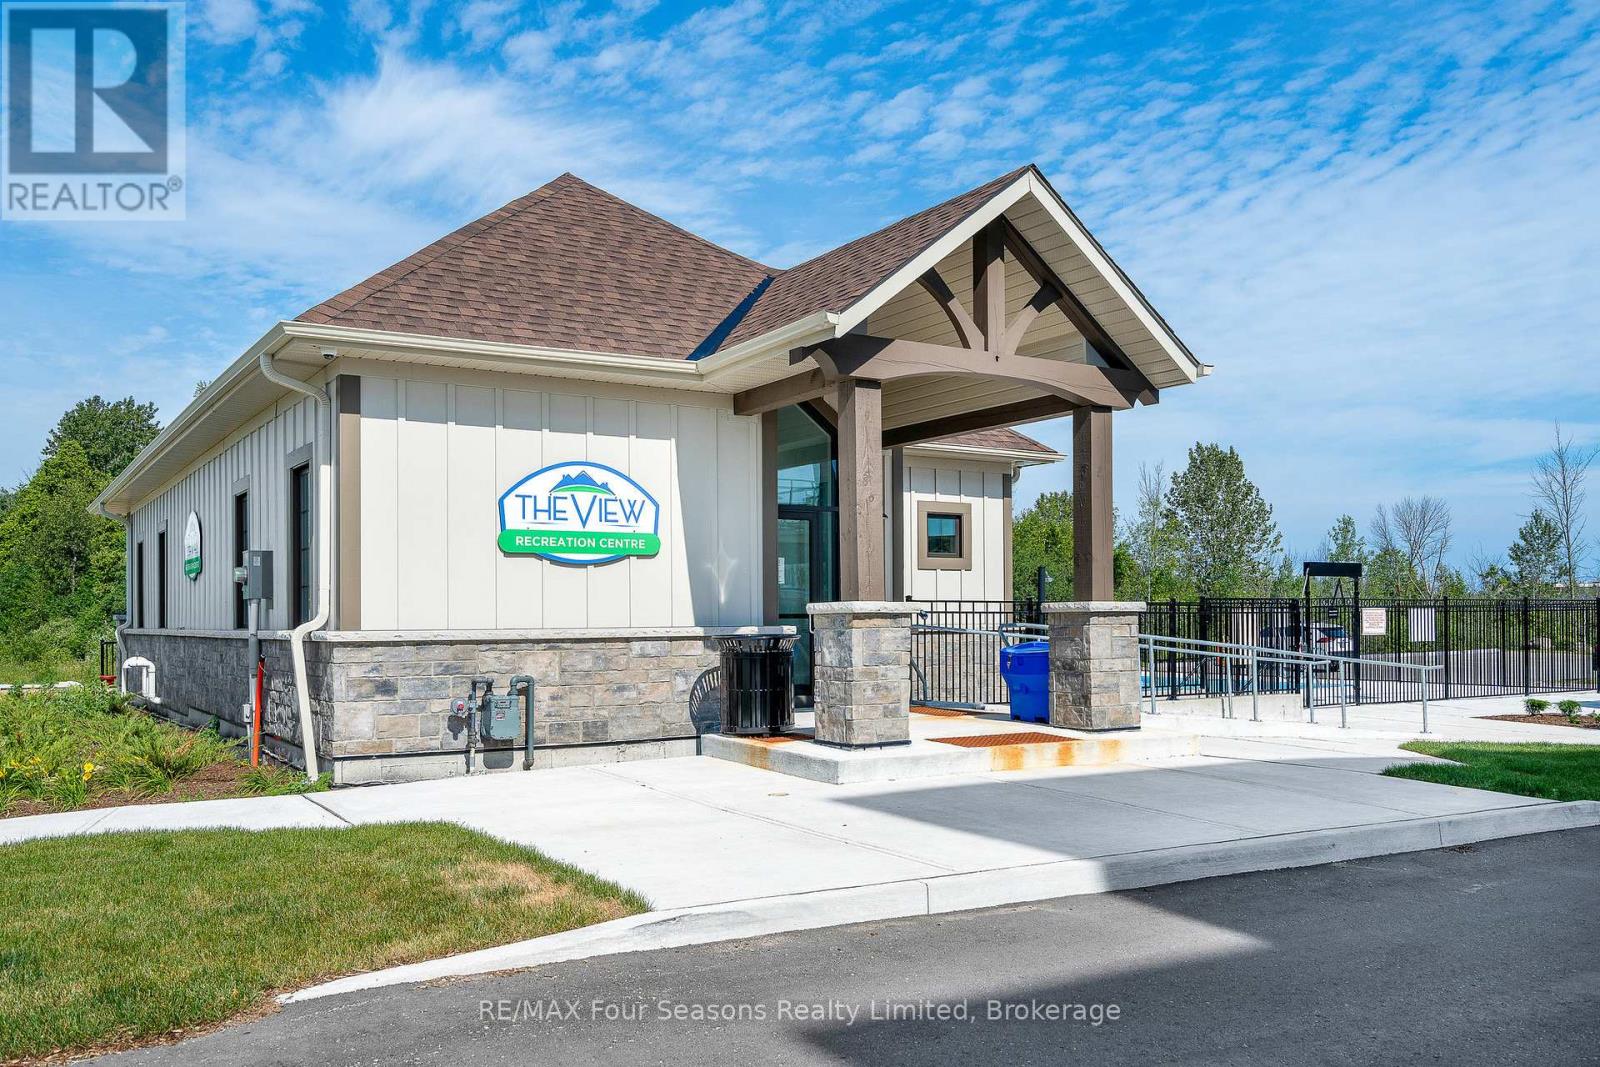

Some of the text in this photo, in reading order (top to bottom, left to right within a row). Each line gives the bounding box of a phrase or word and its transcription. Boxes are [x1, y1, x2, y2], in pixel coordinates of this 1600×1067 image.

[515, 494, 568, 521] THE
[515, 535, 646, 549] RECREATION CENTRE
